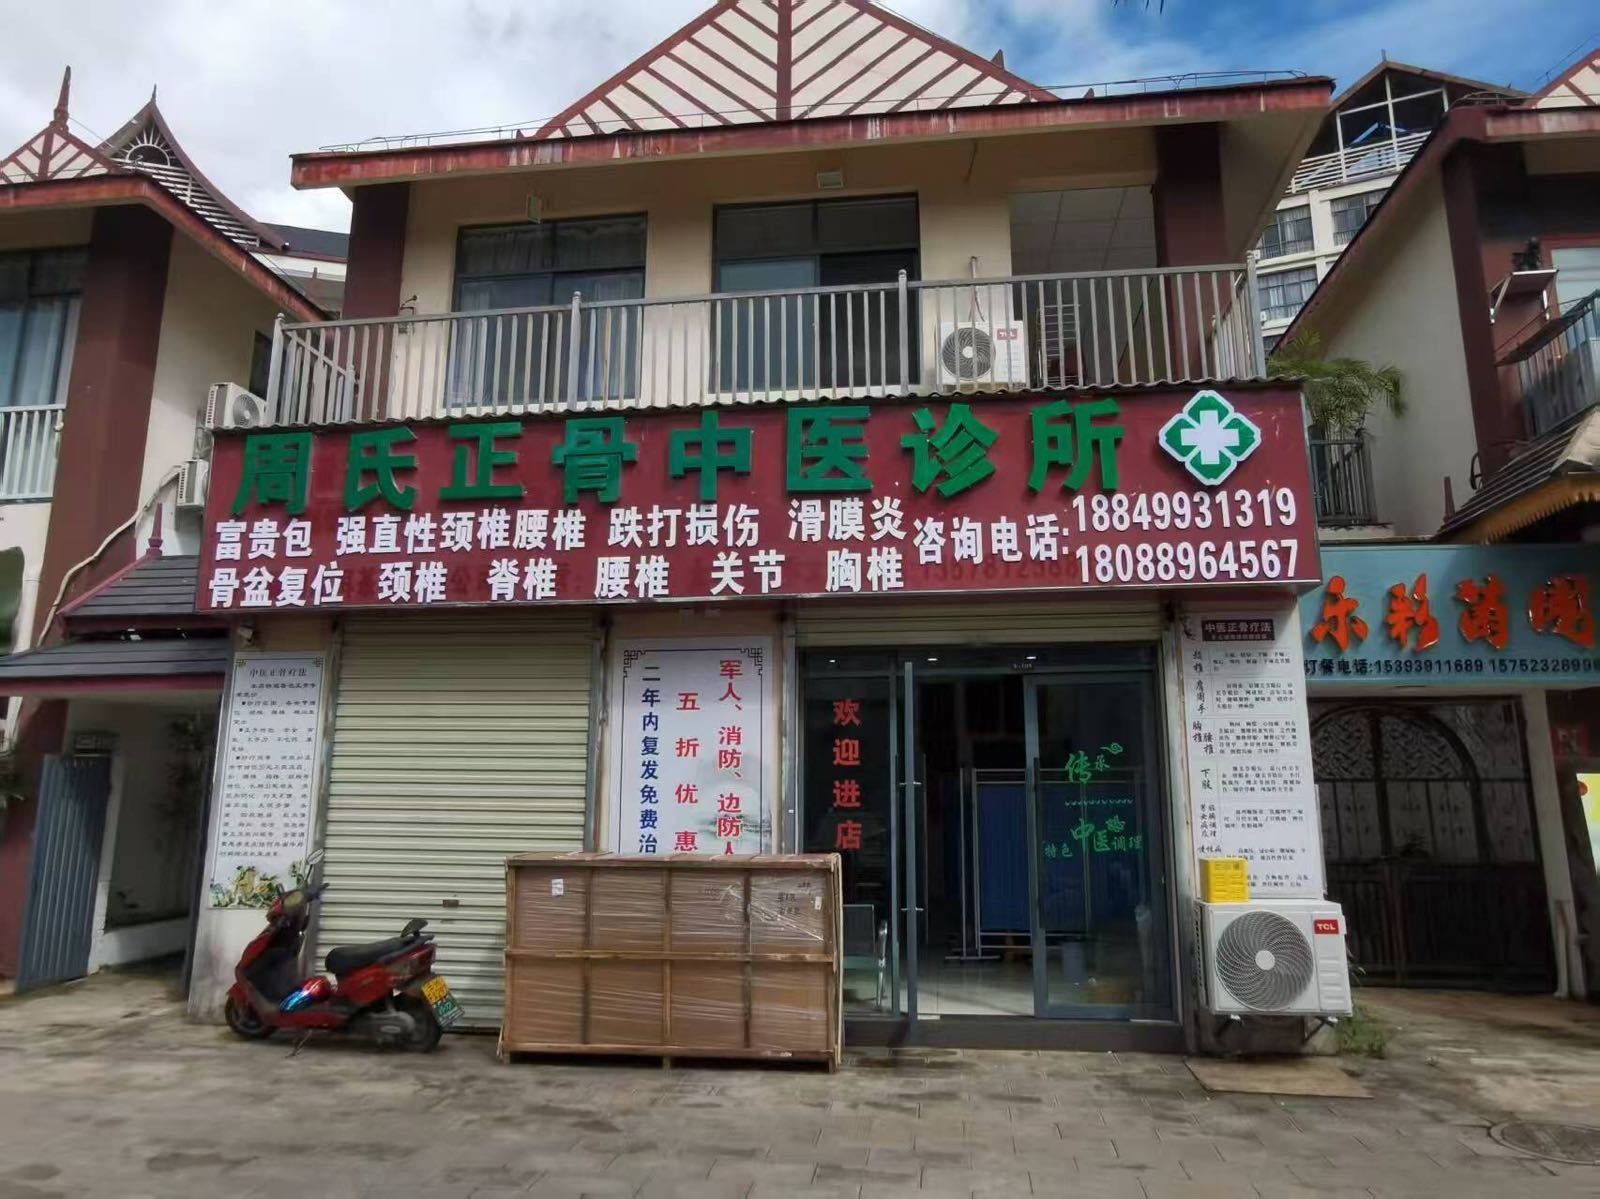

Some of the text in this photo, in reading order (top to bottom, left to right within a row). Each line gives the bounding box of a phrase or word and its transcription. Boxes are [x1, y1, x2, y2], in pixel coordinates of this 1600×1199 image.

[232, 397, 1125, 518] 周氏正骨中医诊所
[216, 496, 907, 561] 富贵包 强直性颈椎腰椎 跌打损伤 滑膜炎
[913, 513, 1070, 566] 咨询电话:
[1072, 487, 1297, 533] 18849931319
[208, 560, 344, 609] 骨盆复位
[379, 559, 448, 604] 颈椎
[486, 556, 558, 602] 脊椎
[594, 554, 670, 600] 腰椎
[709, 549, 785, 596] 关节
[826, 545, 905, 594] 胸椎
[1076, 539, 1299, 584] 18088964567
[638, 666, 661, 854] 二年内复发免费治
[674, 691, 701, 852] 五折优惠
[832, 699, 863, 850] 欢迎进店
[1065, 750, 1110, 784] 传承
[1316, 923, 1337, 931] TCL
